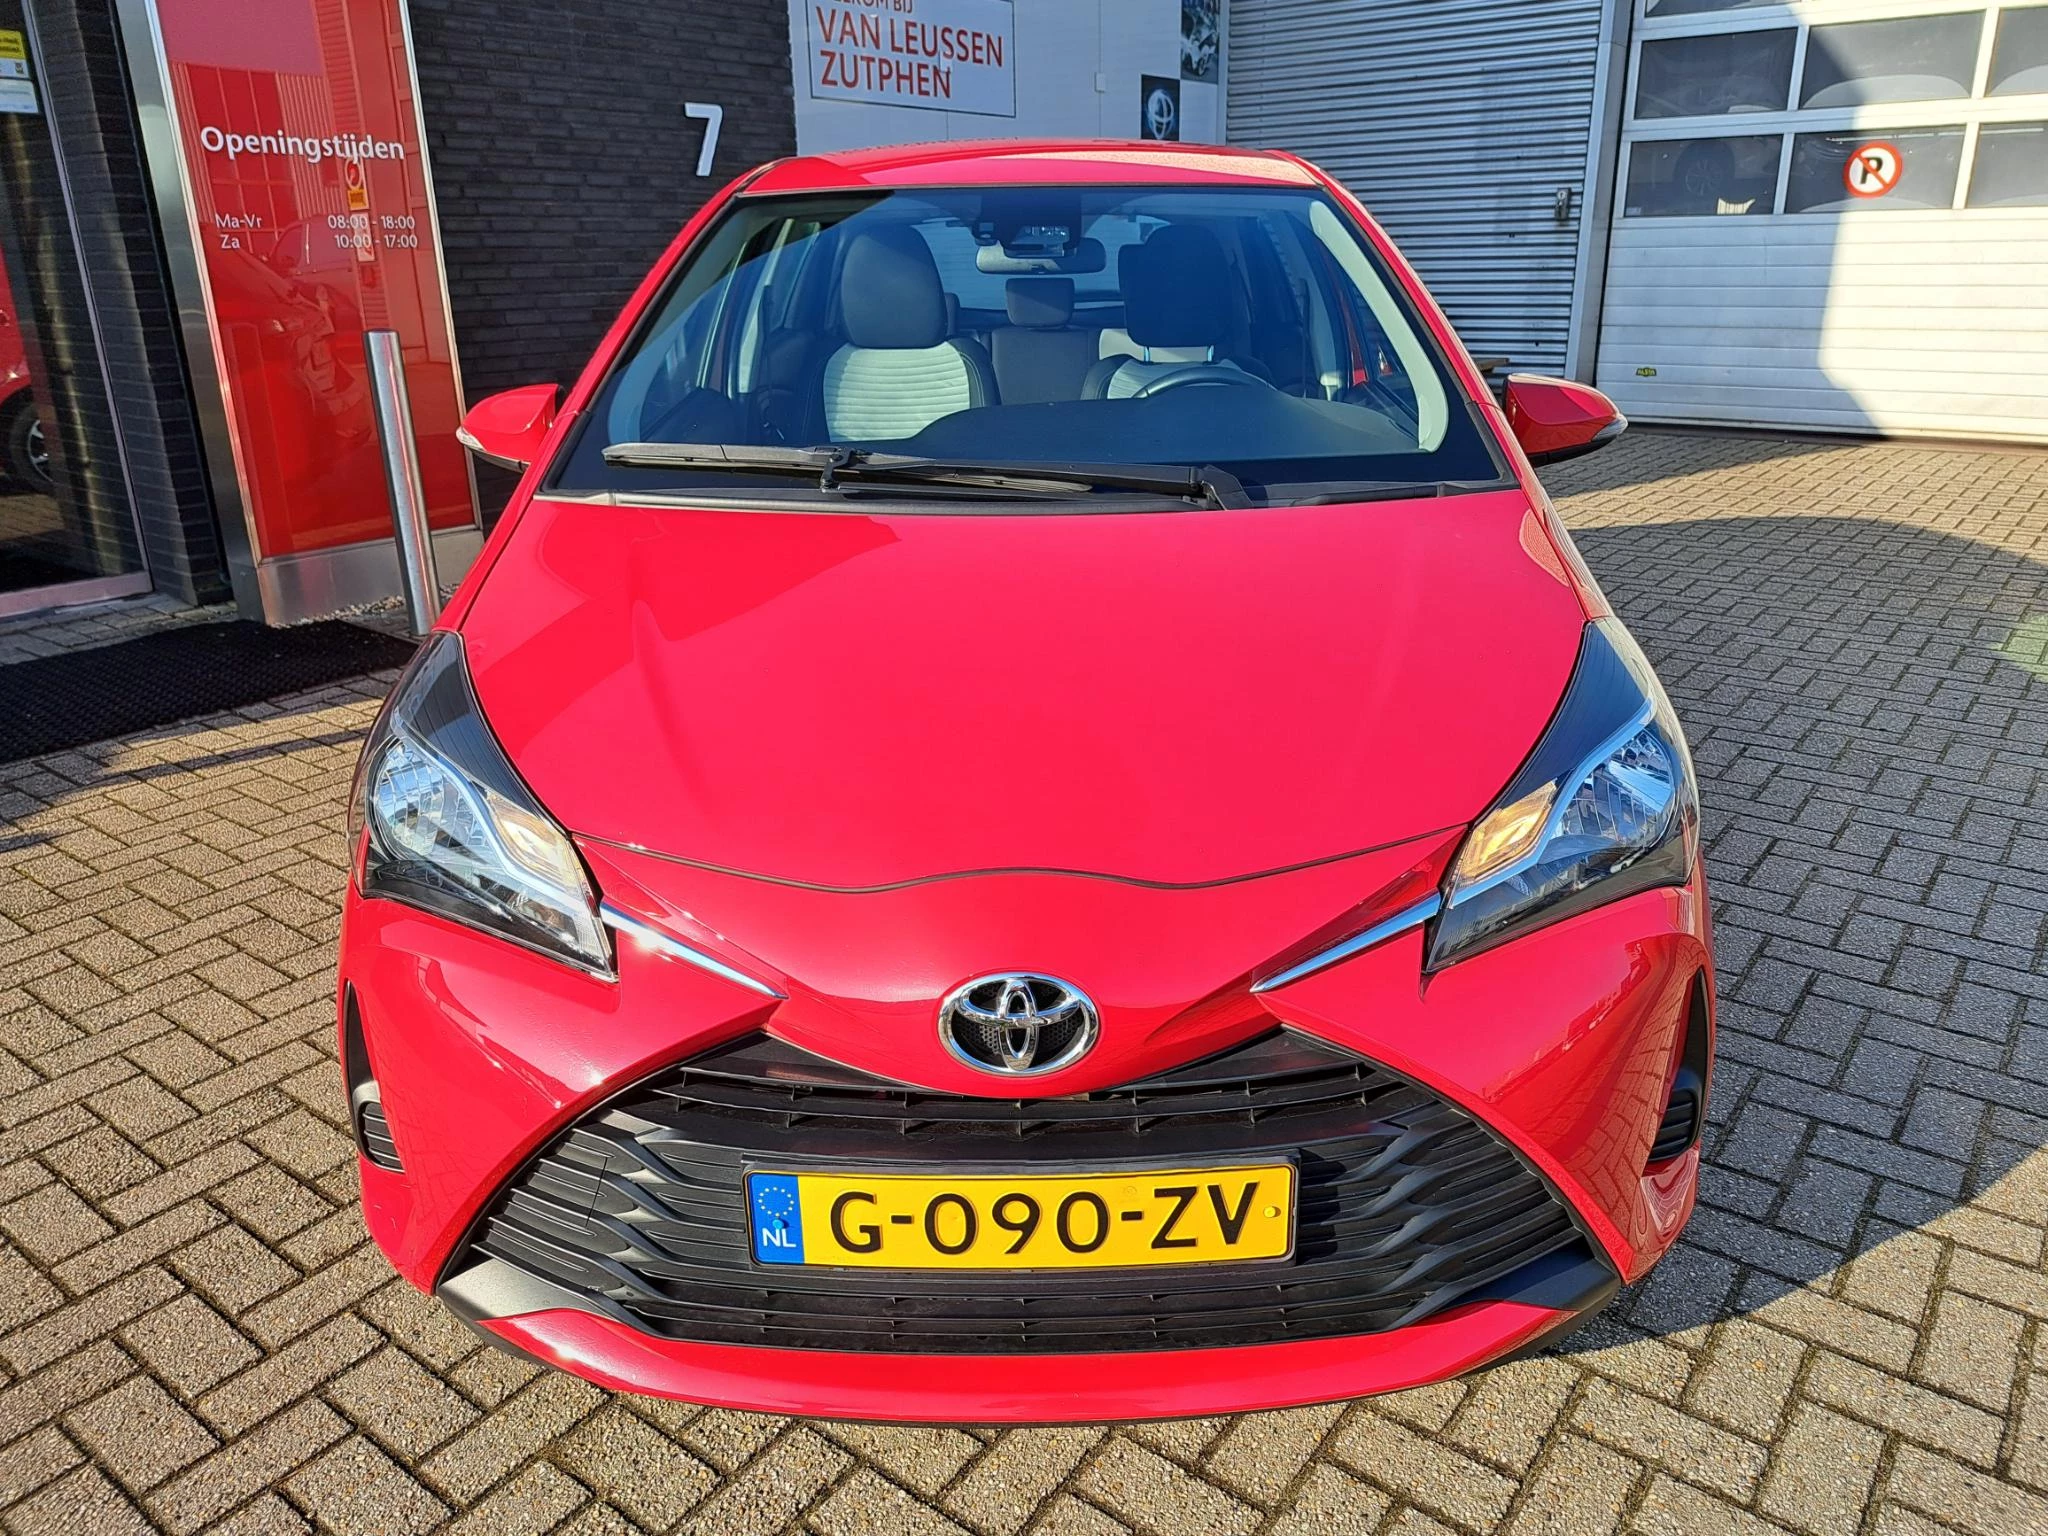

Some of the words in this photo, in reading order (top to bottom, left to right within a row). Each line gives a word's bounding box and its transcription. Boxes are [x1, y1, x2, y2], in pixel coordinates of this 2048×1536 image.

[816, 6, 881, 50] VAN
[889, 18, 1003, 68] LEUSSEN
[820, 50, 951, 99] ZUTPHEN
[200, 126, 405, 164] Openingstijden
[684, 102, 723, 177] 7
[215, 213, 262, 229] Ma-Vr
[327, 215, 368, 230] 08:00
[381, 216, 416, 230] 18:00
[220, 235, 241, 249] Za
[334, 235, 372, 249] 10:00
[384, 235, 418, 249] 17:00
[761, 1227, 797, 1249] NL
[829, 1181, 1260, 1256] G-090-ZV
